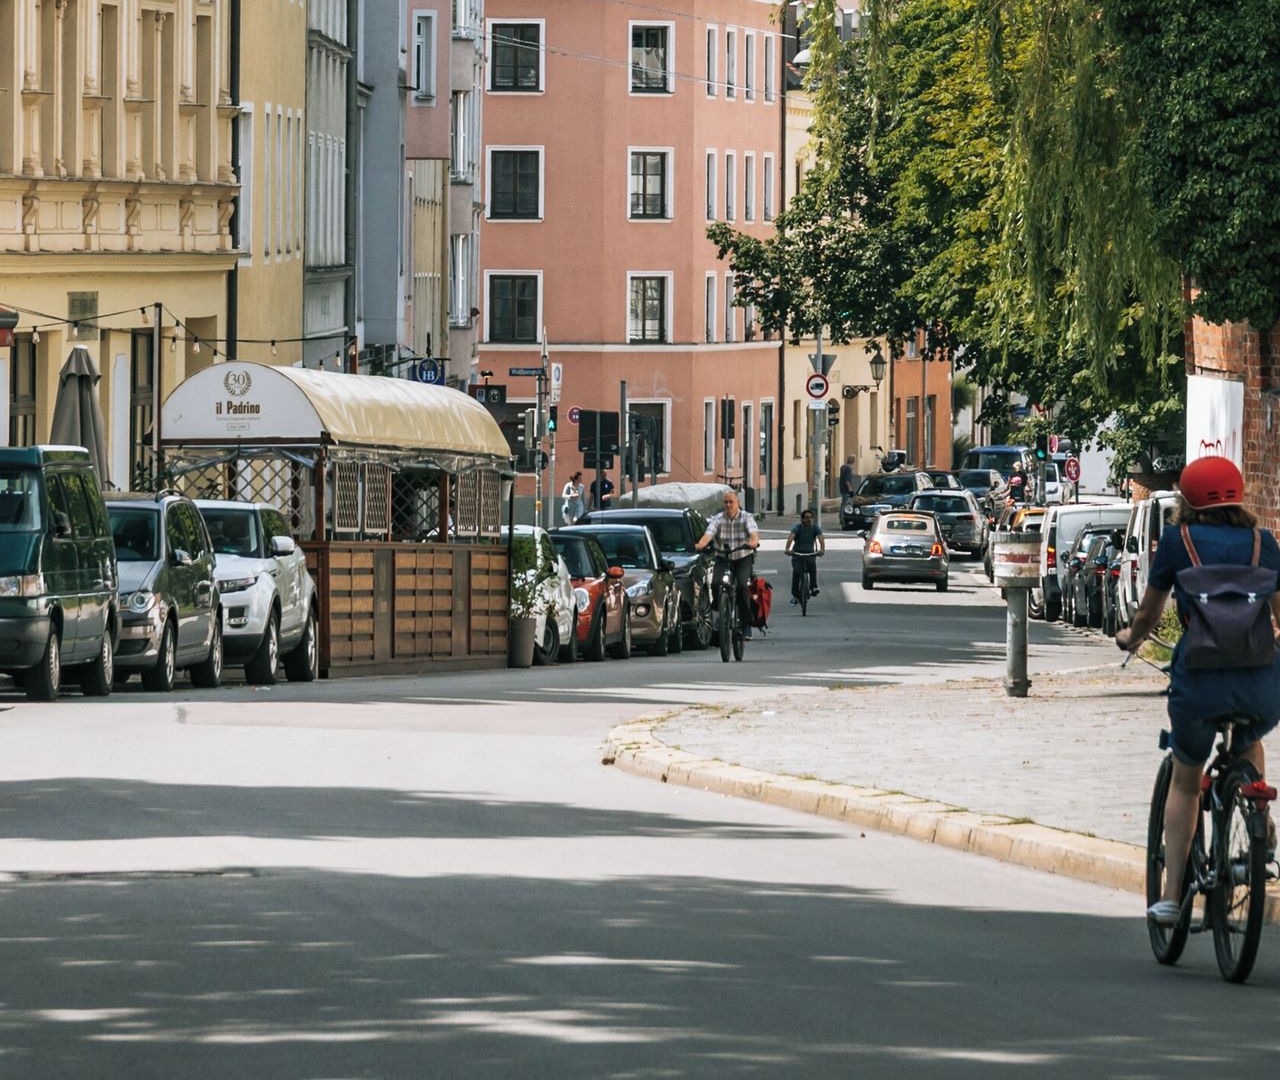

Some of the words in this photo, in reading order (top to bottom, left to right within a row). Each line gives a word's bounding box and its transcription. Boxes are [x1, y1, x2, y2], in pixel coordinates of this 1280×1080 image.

[230, 373, 246, 386] 30
[422, 370, 435, 381] HB
[216, 402, 222, 414] il
[227, 401, 260, 414] Padrino
